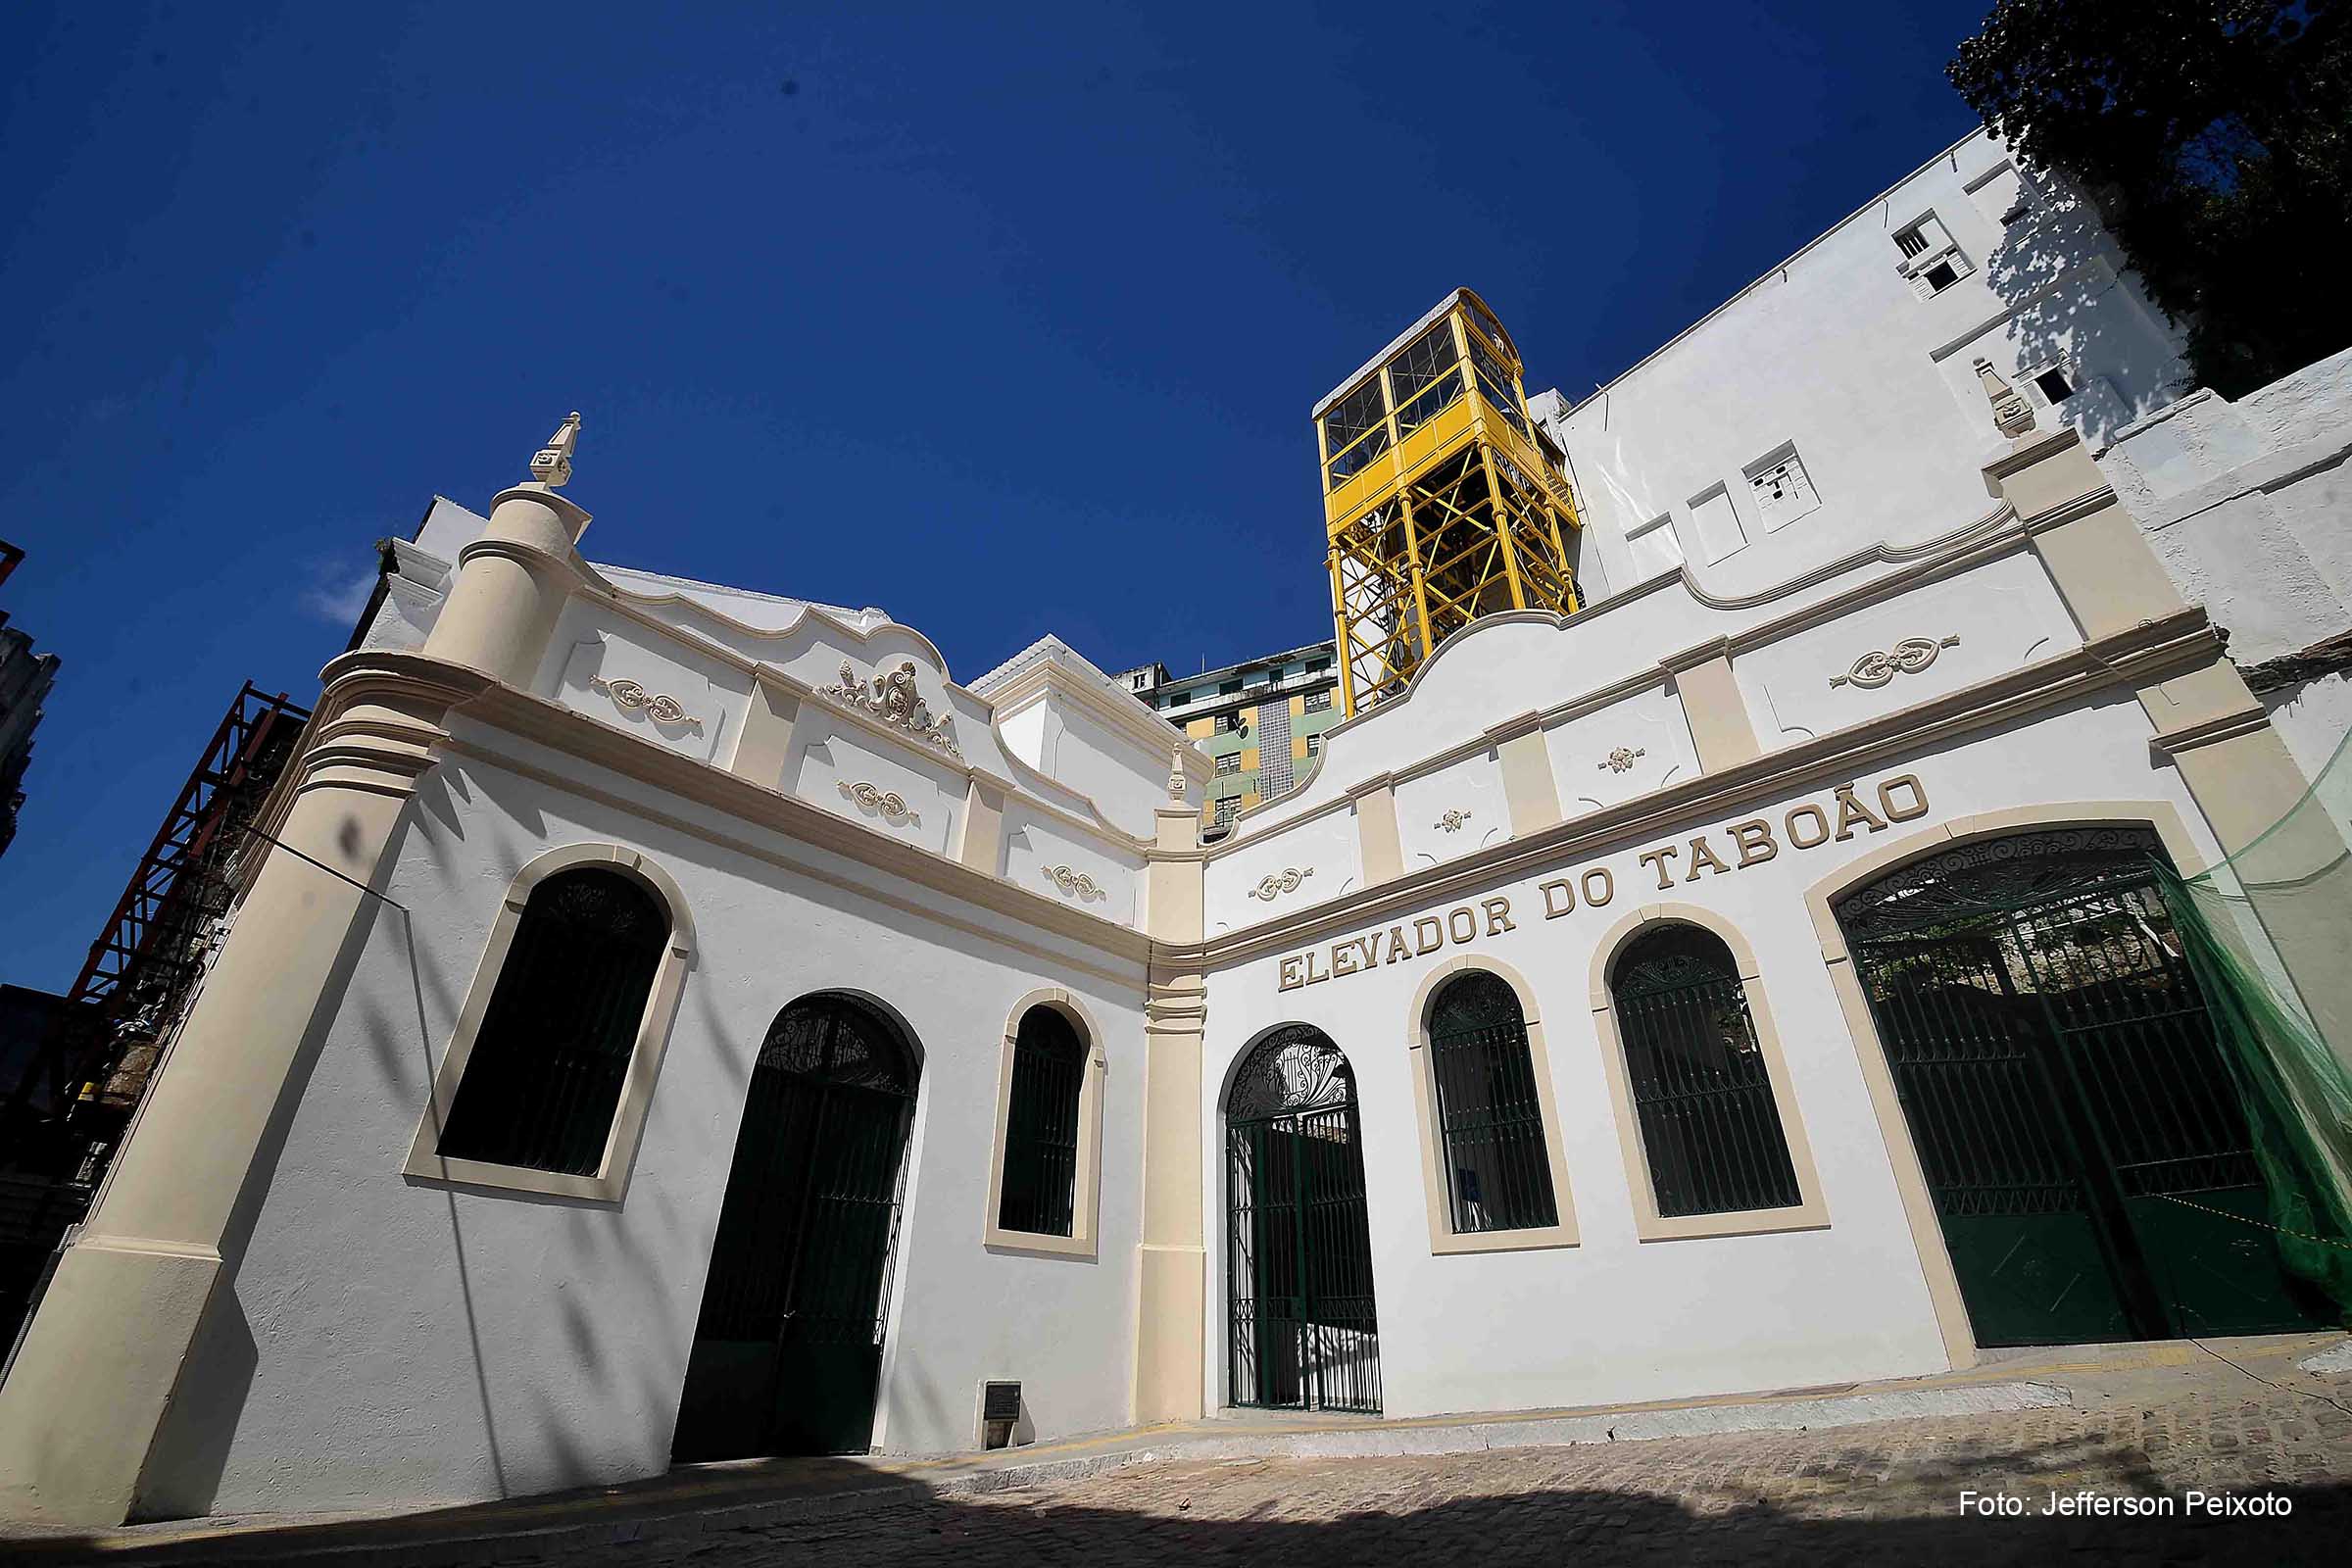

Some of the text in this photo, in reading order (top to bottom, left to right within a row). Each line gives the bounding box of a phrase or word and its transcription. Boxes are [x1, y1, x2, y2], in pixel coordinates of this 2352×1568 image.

[1278, 774, 1930, 993] ELEVADOR DO TABOÃO
